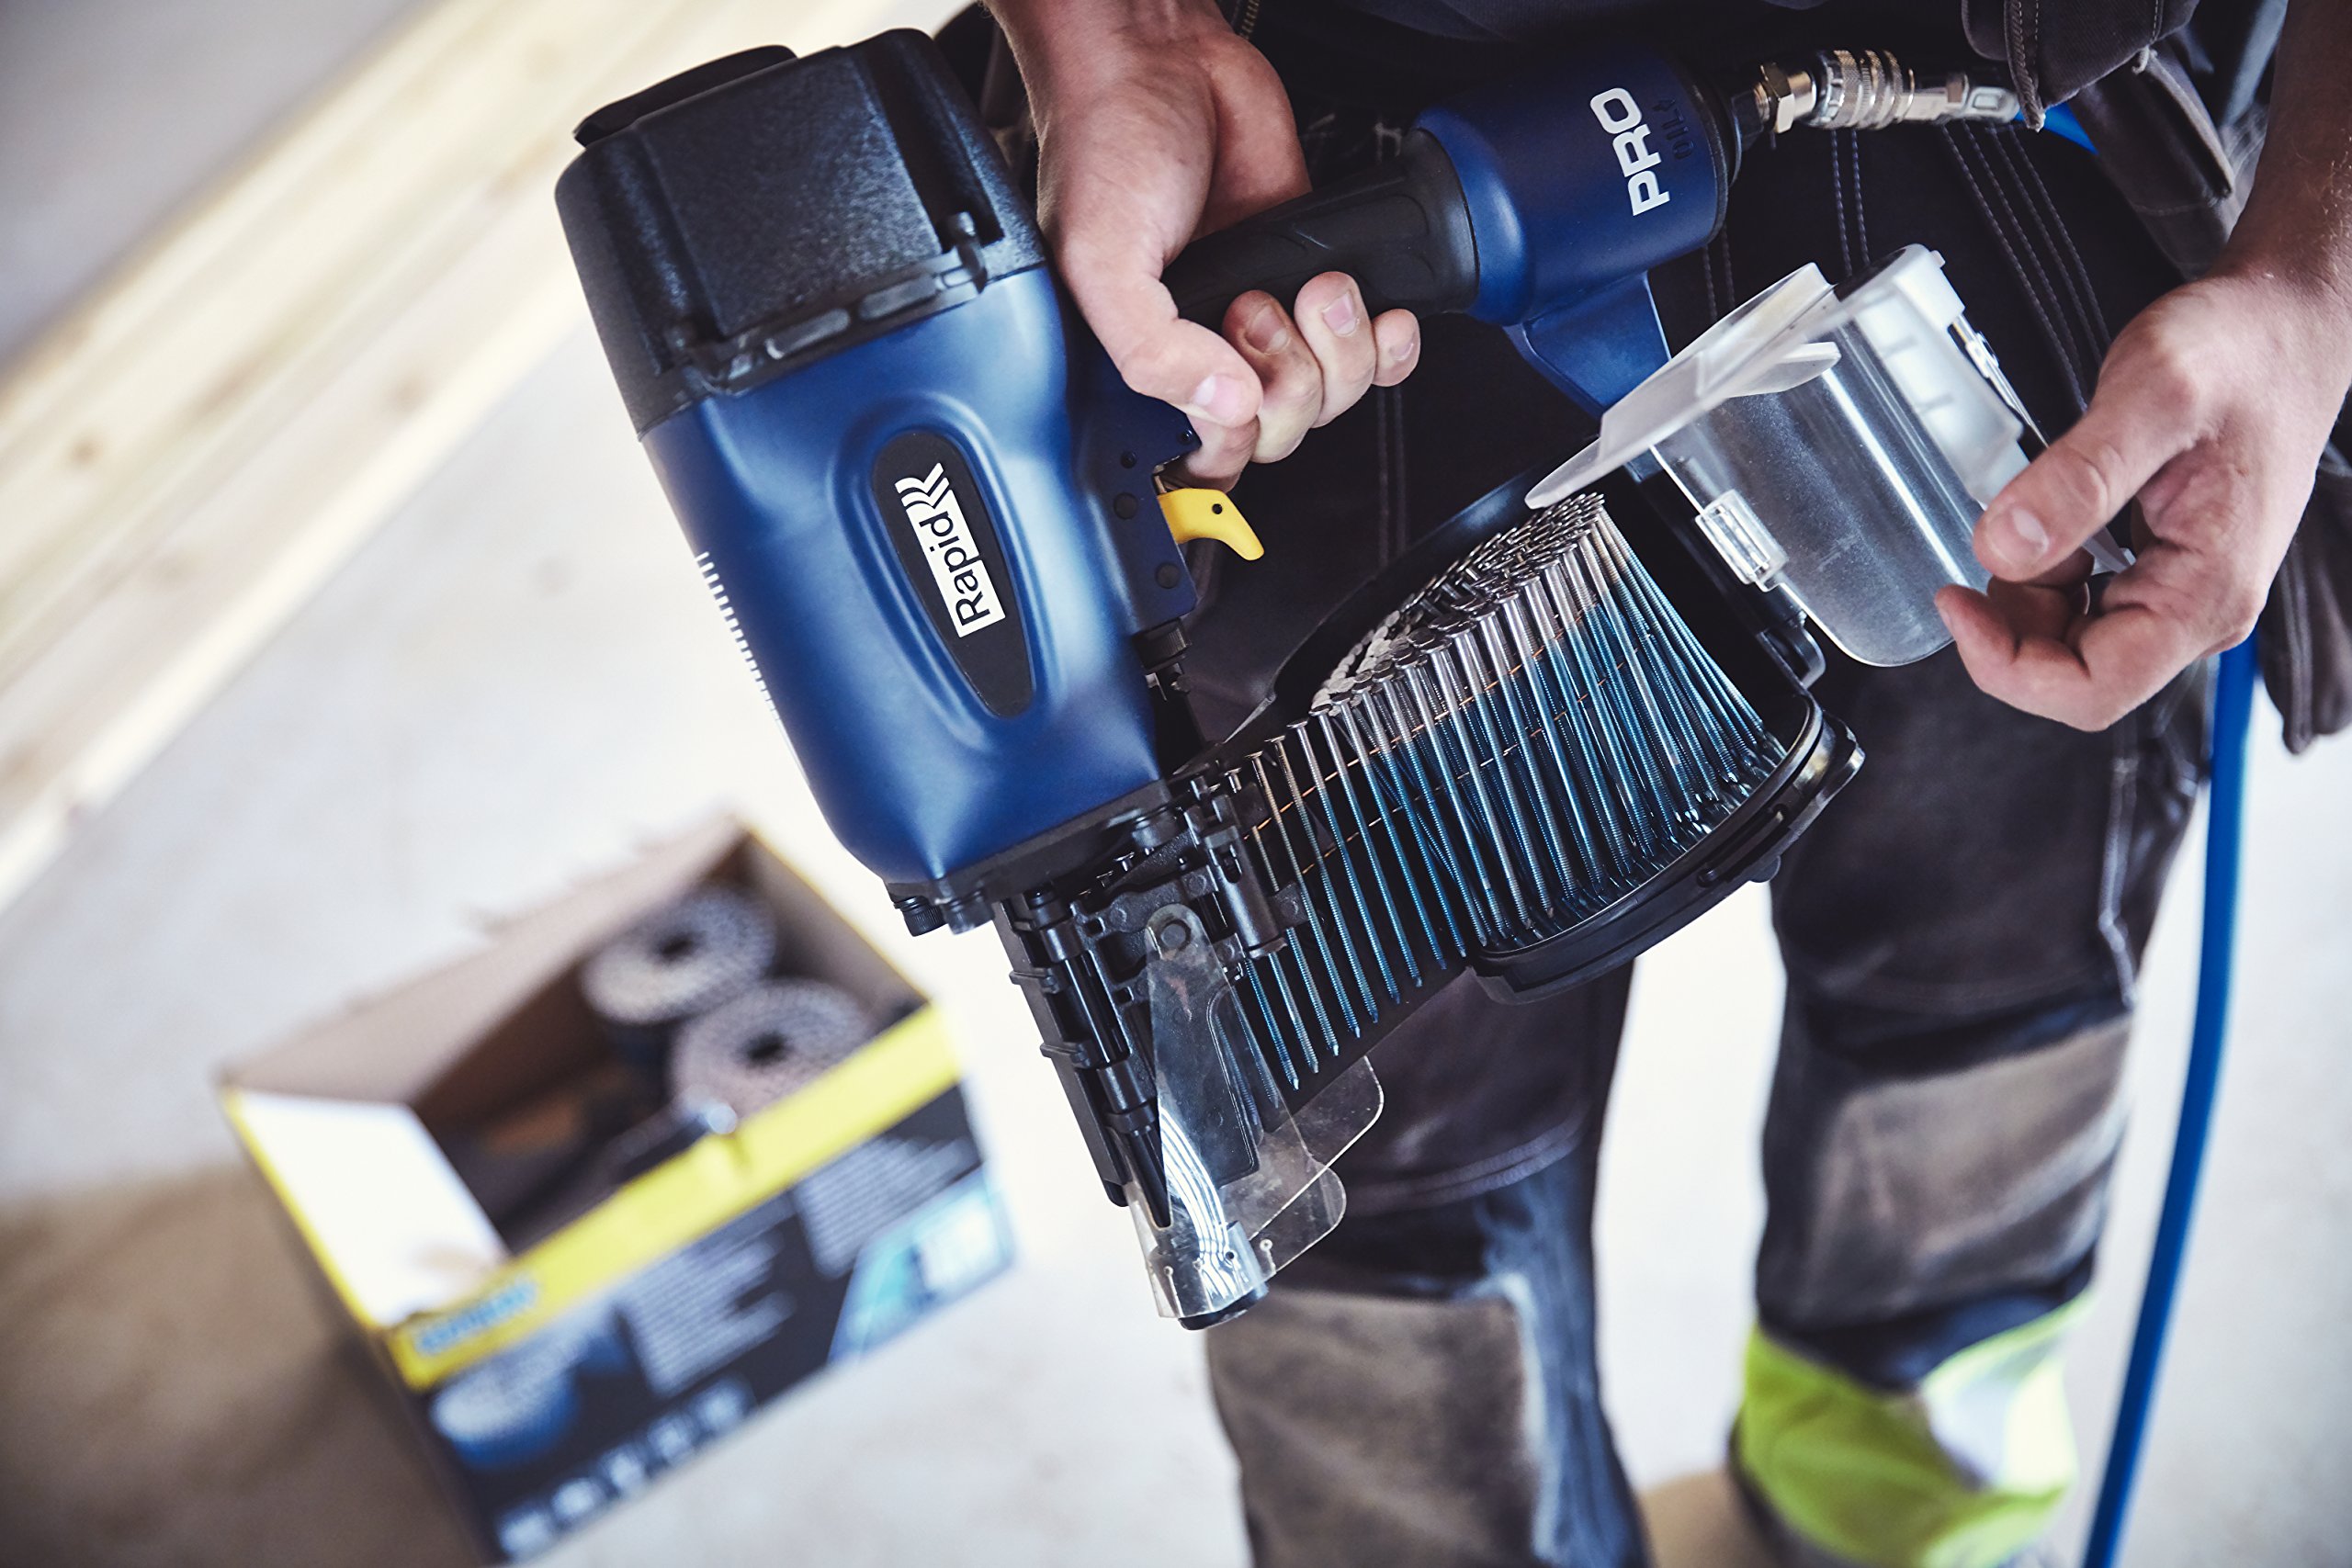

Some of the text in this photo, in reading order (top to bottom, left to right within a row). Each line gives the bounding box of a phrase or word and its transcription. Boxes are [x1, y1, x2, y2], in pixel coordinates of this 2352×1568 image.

[1589, 87, 1670, 216] PRO
[1661, 107, 1694, 160] OIL
[919, 511, 991, 626] Rapid
